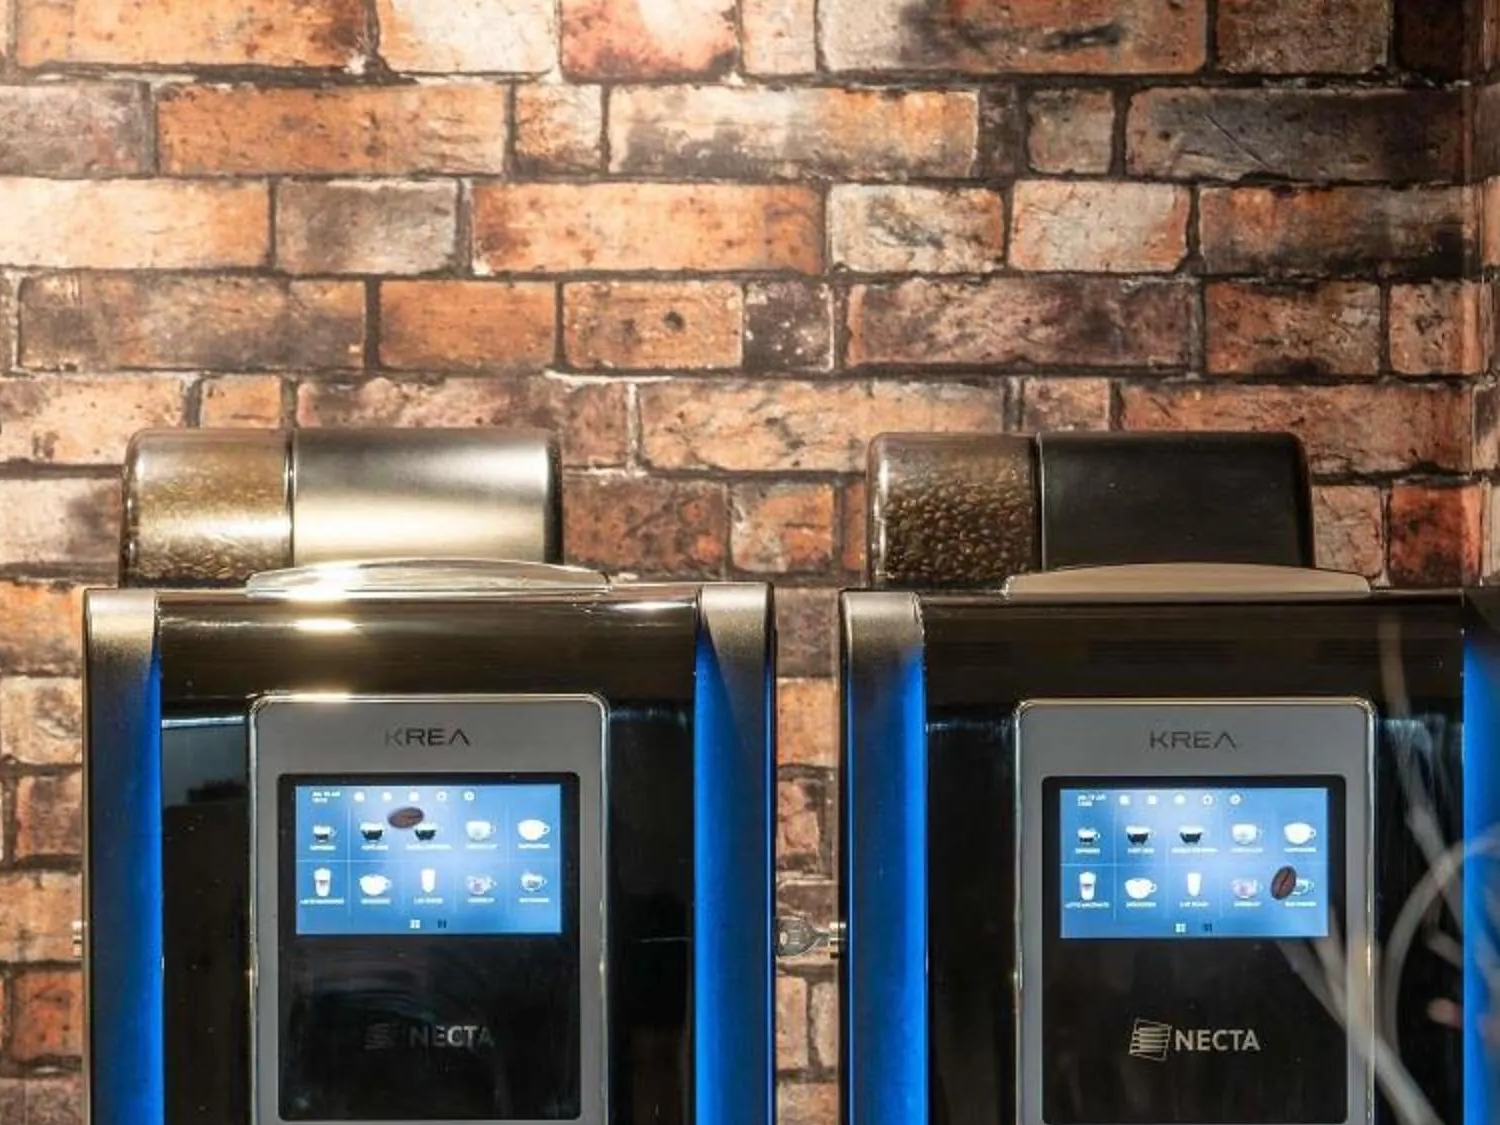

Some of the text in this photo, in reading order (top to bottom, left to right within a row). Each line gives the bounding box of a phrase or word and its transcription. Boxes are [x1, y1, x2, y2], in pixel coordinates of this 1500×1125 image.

[384, 728, 471, 747] KREA
[1150, 730, 1238, 749] KREA
[408, 1025, 495, 1048] NECTA
[1174, 1029, 1261, 1051] NECTA
